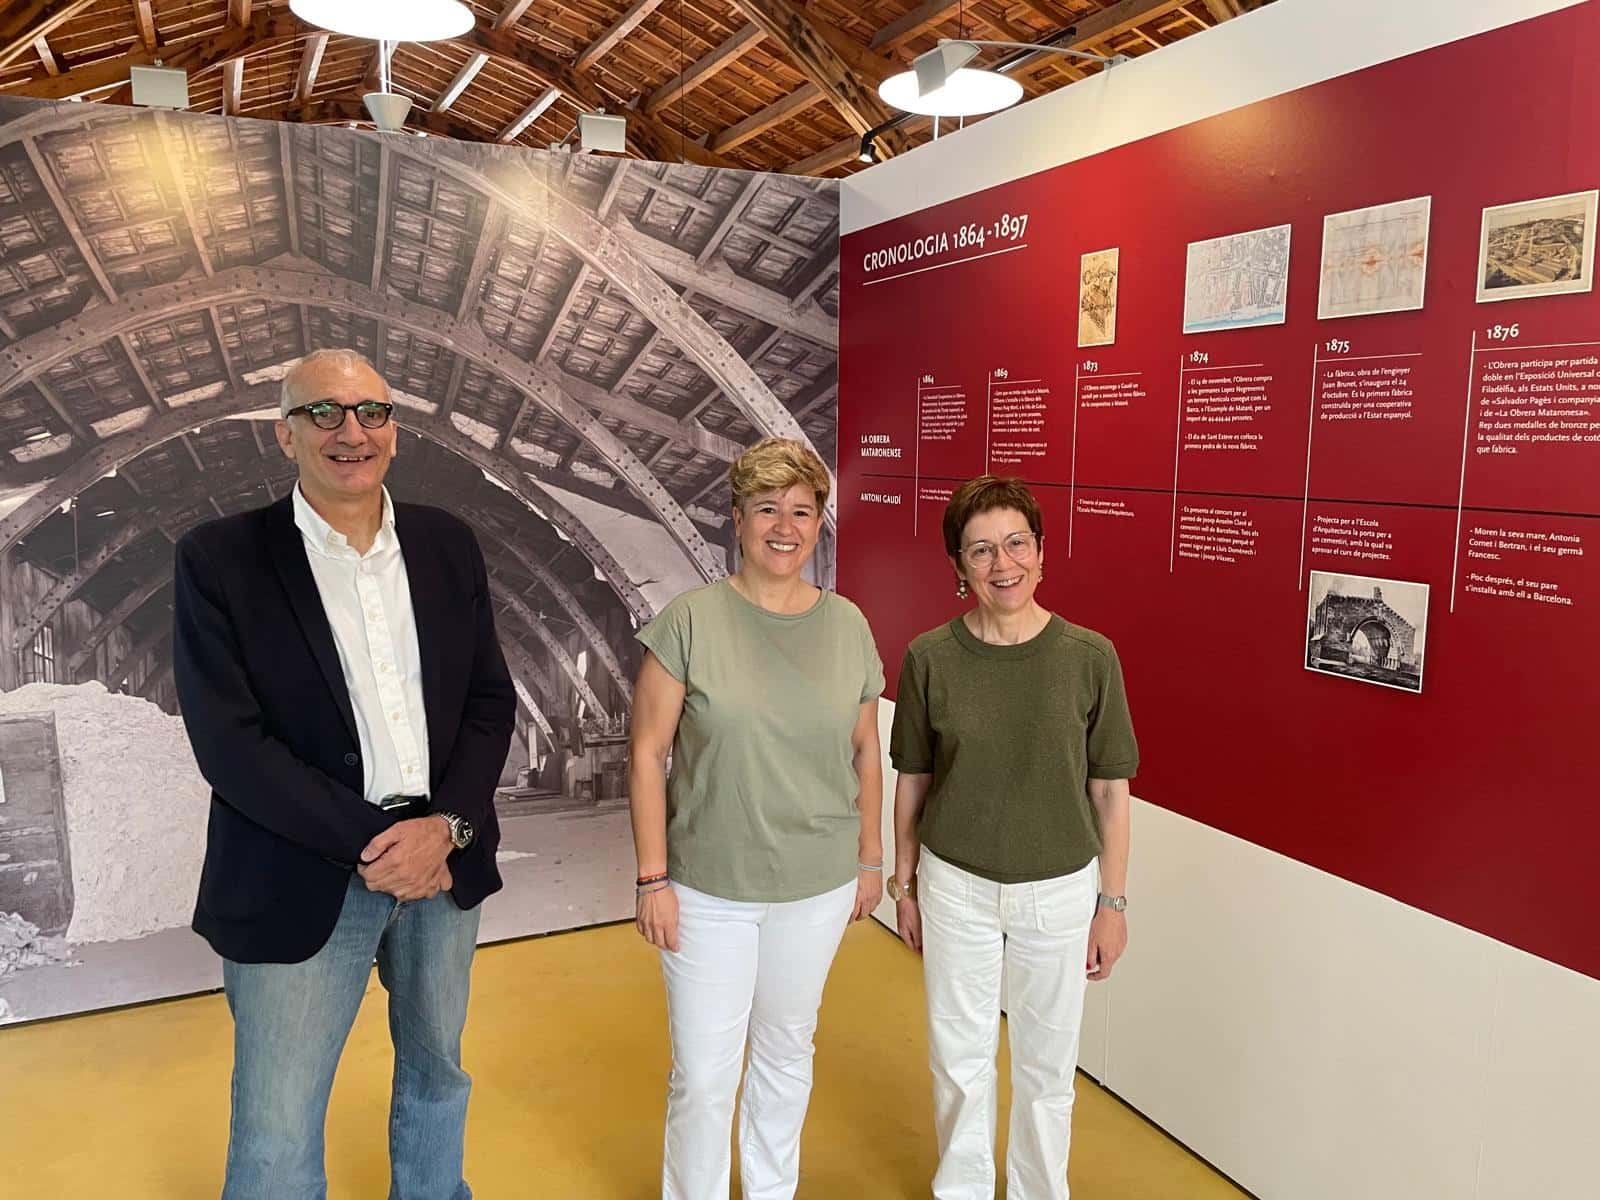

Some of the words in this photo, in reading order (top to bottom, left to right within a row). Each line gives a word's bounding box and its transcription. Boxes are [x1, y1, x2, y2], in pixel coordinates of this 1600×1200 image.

[863, 232, 949, 272] CRONOLOGIA
[1486, 324, 1520, 341] 1876
[1325, 338, 1350, 353] 1875
[1190, 350, 1208, 364] 1874
[1083, 360, 1098, 372] 1873
[1521, 359, 1552, 370] participa
[1570, 357, 1598, 367] partida
[994, 368, 1008, 378] 1869
[1381, 367, 1410, 376] l'enginyer
[1516, 372, 1555, 382] l'Exposició
[1558, 370, 1594, 378] Universal
[1367, 390, 1389, 398] primera
[1376, 400, 1411, 409] cooperativa
[1479, 421, 1492, 431] Rep
[861, 435, 867, 444] LA
[869, 435, 890, 444] OBRERA
[1486, 433, 1512, 443] qualitat
[1532, 434, 1570, 443] productes
[861, 448, 901, 457] MATARONENSE
[861, 493, 881, 502] ANTONI
[1317, 516, 1339, 525] Projecta
[1474, 528, 1498, 536] Moren
[1469, 538, 1492, 547] Cornet
[1499, 541, 1527, 551] Bertran,
[1468, 549, 1501, 559] Francesc.
[1471, 573, 1483, 581] Poc
[1485, 575, 1515, 586] després,
[1534, 593, 1573, 604] Barcelona.
